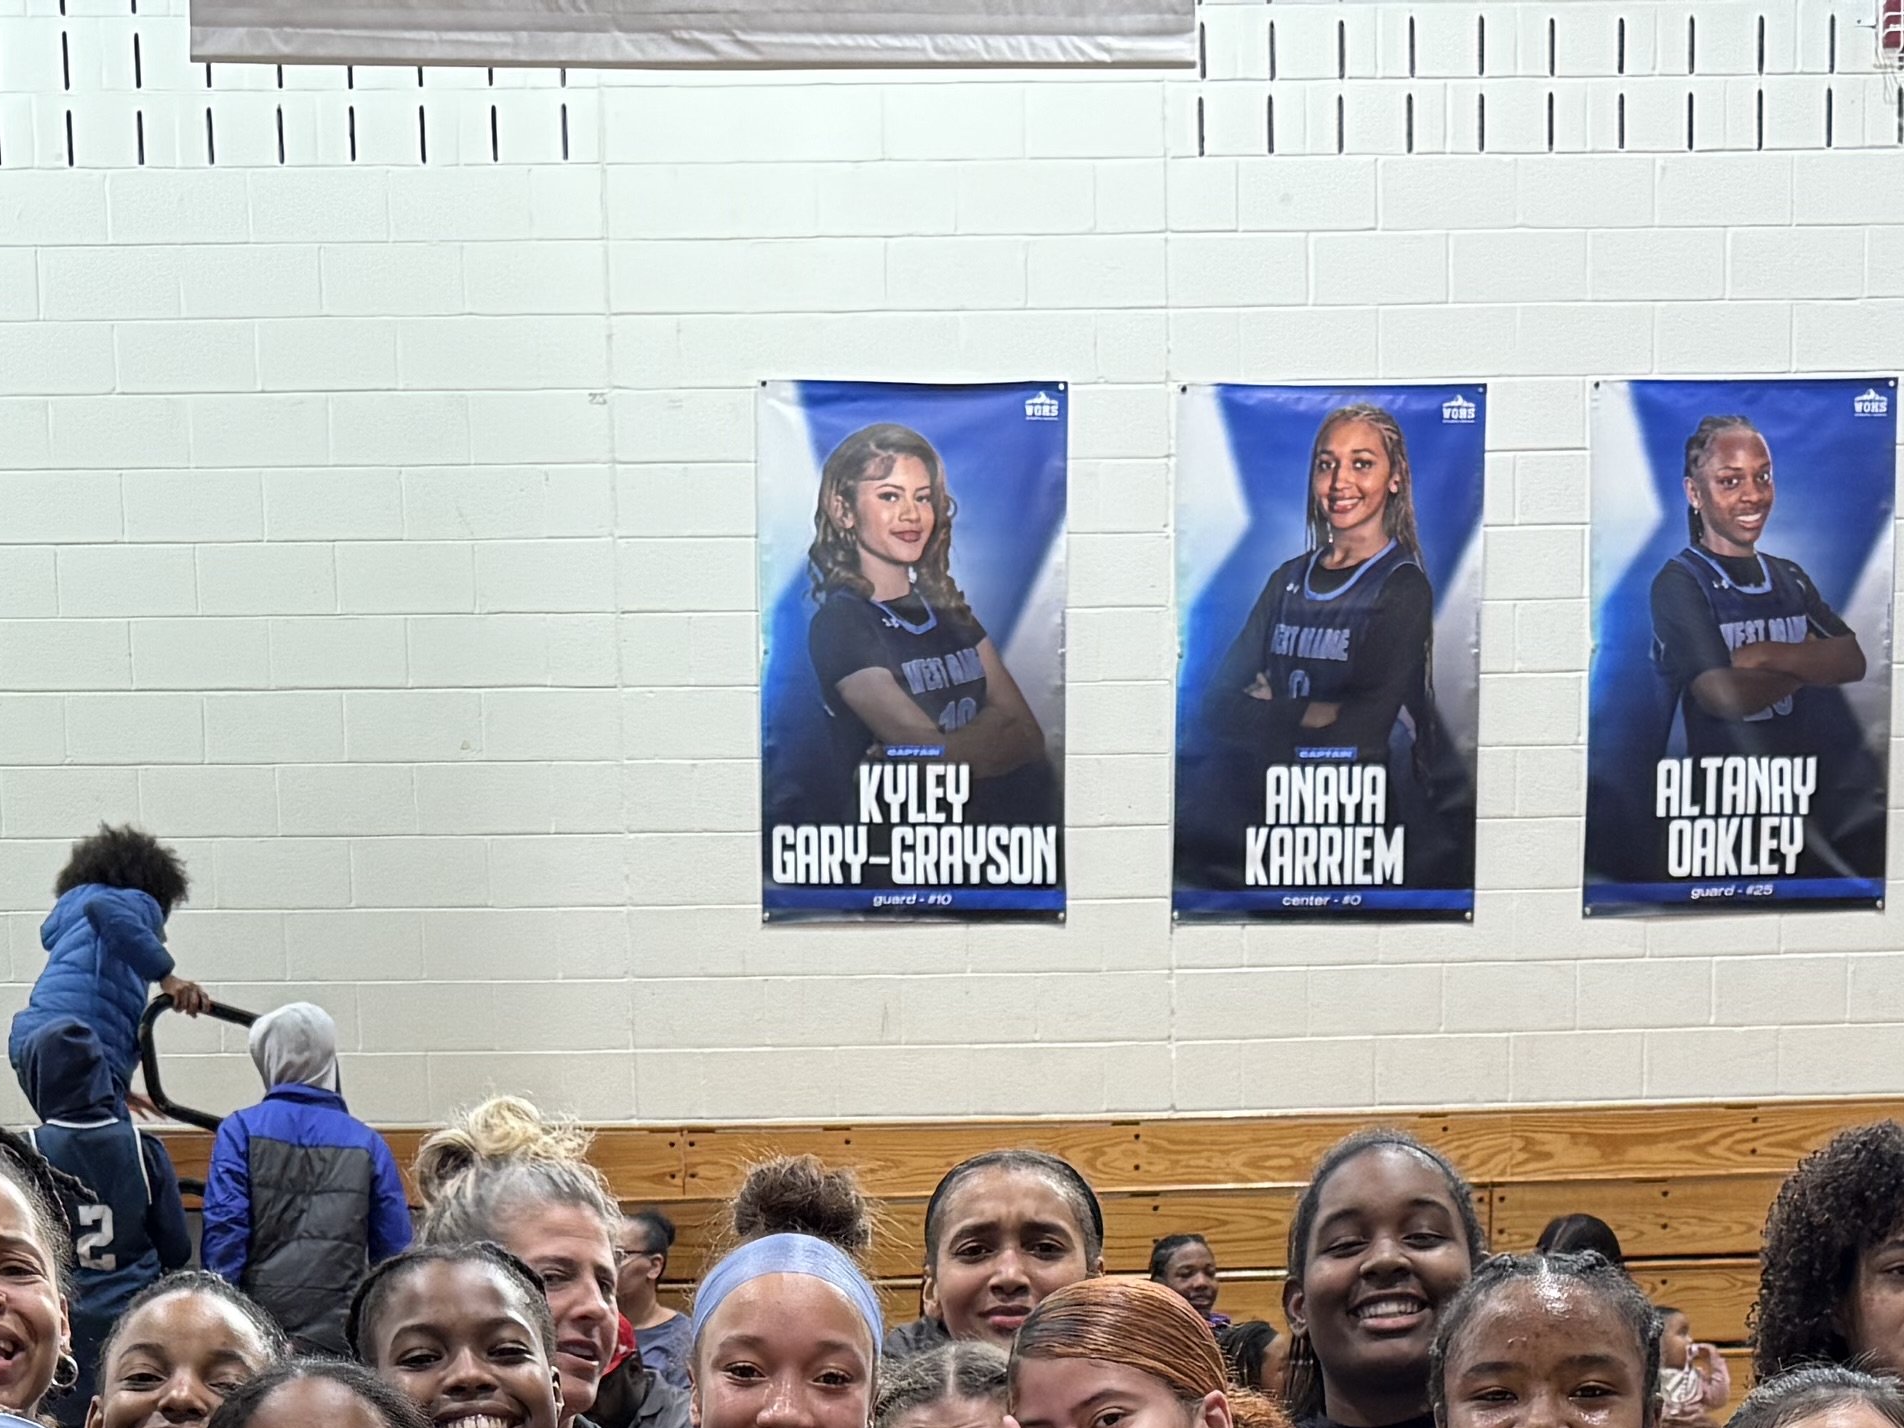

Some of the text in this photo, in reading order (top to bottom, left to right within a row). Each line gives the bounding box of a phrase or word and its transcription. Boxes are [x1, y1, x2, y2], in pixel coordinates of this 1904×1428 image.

[859, 763, 971, 823] KYLEY
[1266, 765, 1386, 825] ANAYA
[1656, 755, 1818, 817] ALTANAY
[772, 825, 1058, 885] GARY-GRAYSON
[1245, 825, 1404, 886] KARRIEM
[1668, 816, 1804, 877] OAKLEY
[873, 894, 916, 907] guard
[928, 894, 952, 905] #10
[1282, 895, 1331, 906] center
[1691, 884, 1736, 900] guard
[1746, 884, 1773, 896] #25
